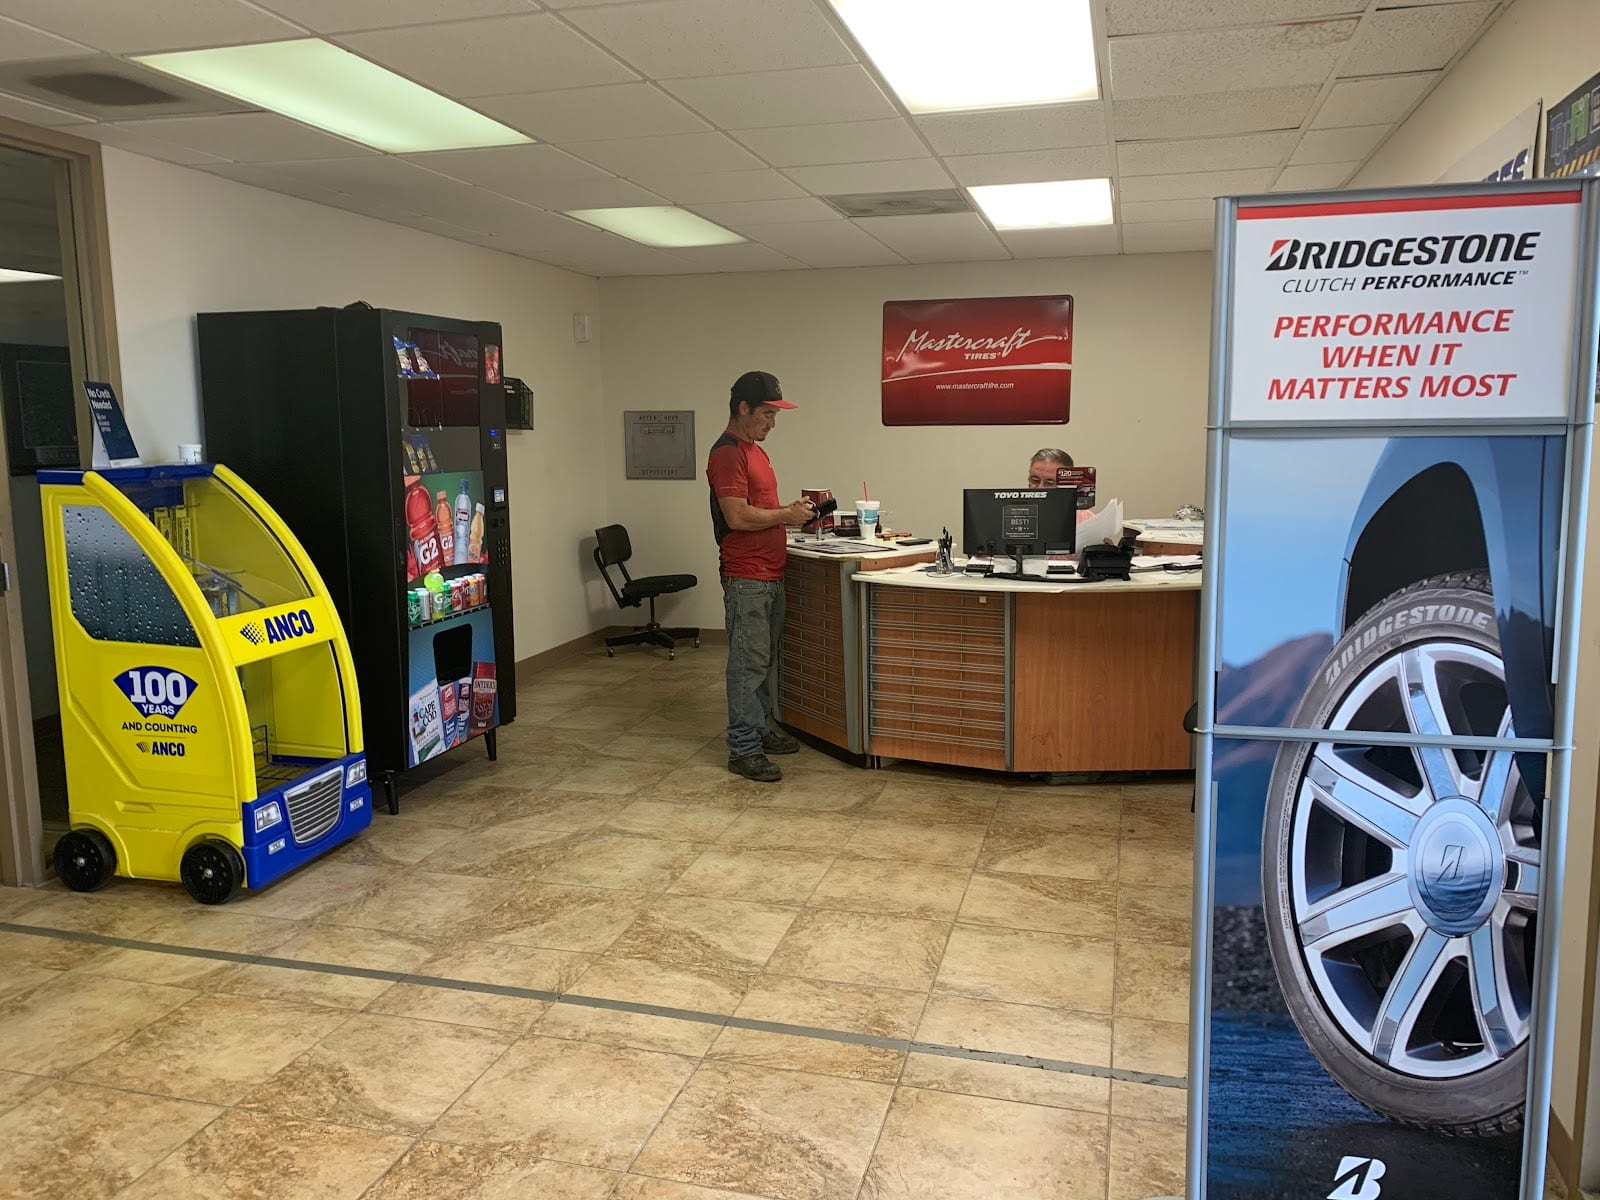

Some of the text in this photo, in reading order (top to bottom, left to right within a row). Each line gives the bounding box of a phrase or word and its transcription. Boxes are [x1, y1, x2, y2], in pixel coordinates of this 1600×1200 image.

[1265, 231, 1541, 271] BRIDGESTONE
[1282, 277, 1356, 293] CLUTCH
[1361, 271, 1517, 291] PERFORMANCE
[1273, 308, 1514, 338] PERFORMANCE
[896, 327, 1034, 362] Mastercraft
[1322, 343, 1462, 368] WHEN IT
[1268, 374, 1517, 400] MATTERS MOST
[994, 491, 1048, 499] TOYO TIRES
[419, 537, 439, 565] G2
[264, 608, 315, 645] ANCO
[1325, 604, 1491, 690] BRIDGESTONE
[129, 670, 188, 705] 100
[142, 704, 175, 716] YEARS
[122, 722, 198, 734] AND COUNTING
[152, 742, 186, 757] ANCO
